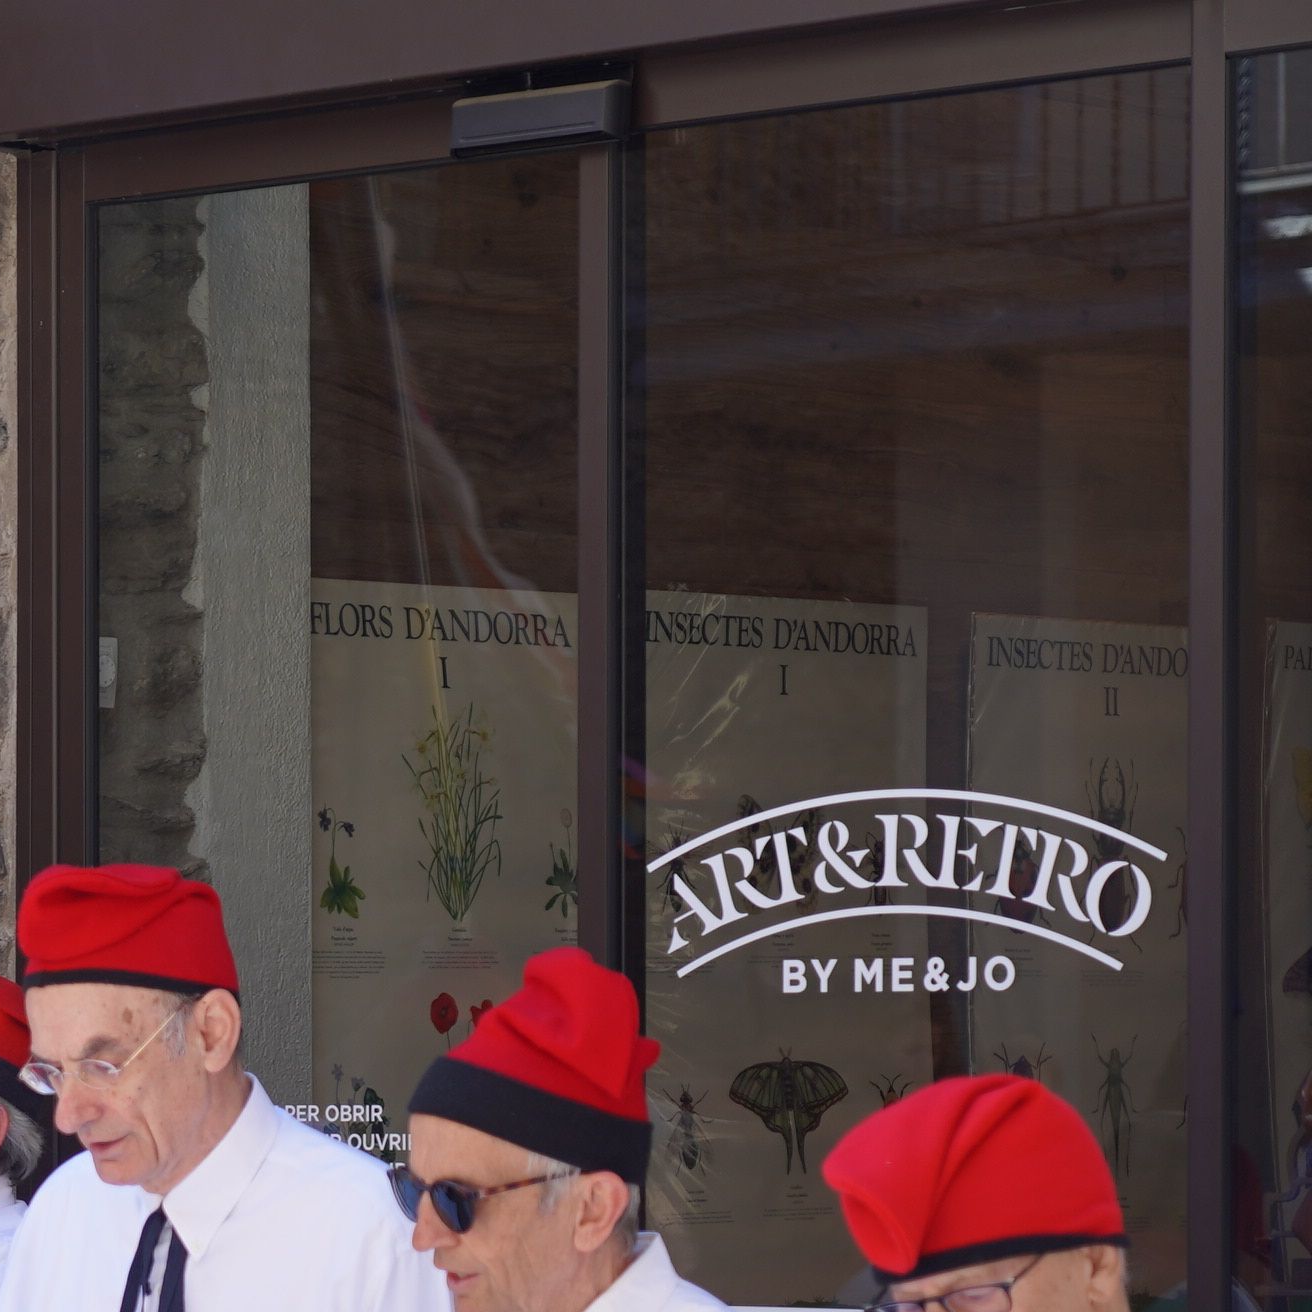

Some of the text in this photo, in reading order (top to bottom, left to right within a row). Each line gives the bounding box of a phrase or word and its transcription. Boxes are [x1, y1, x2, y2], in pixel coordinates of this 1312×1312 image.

[310, 602, 572, 648] FLORS D'ANDORRA
[645, 610, 918, 657] INSECTES D'ANDORRA
[987, 635, 1094, 673] INSECTES
[438, 656, 451, 689] I
[779, 664, 789, 696] I
[1103, 686, 1121, 717] II
[666, 813, 1153, 955] ART&RETRO
[782, 954, 1017, 994] BY ME&JO
[285, 1104, 384, 1122] PER OBRIR
[347, 1133, 412, 1151] OUVRI
